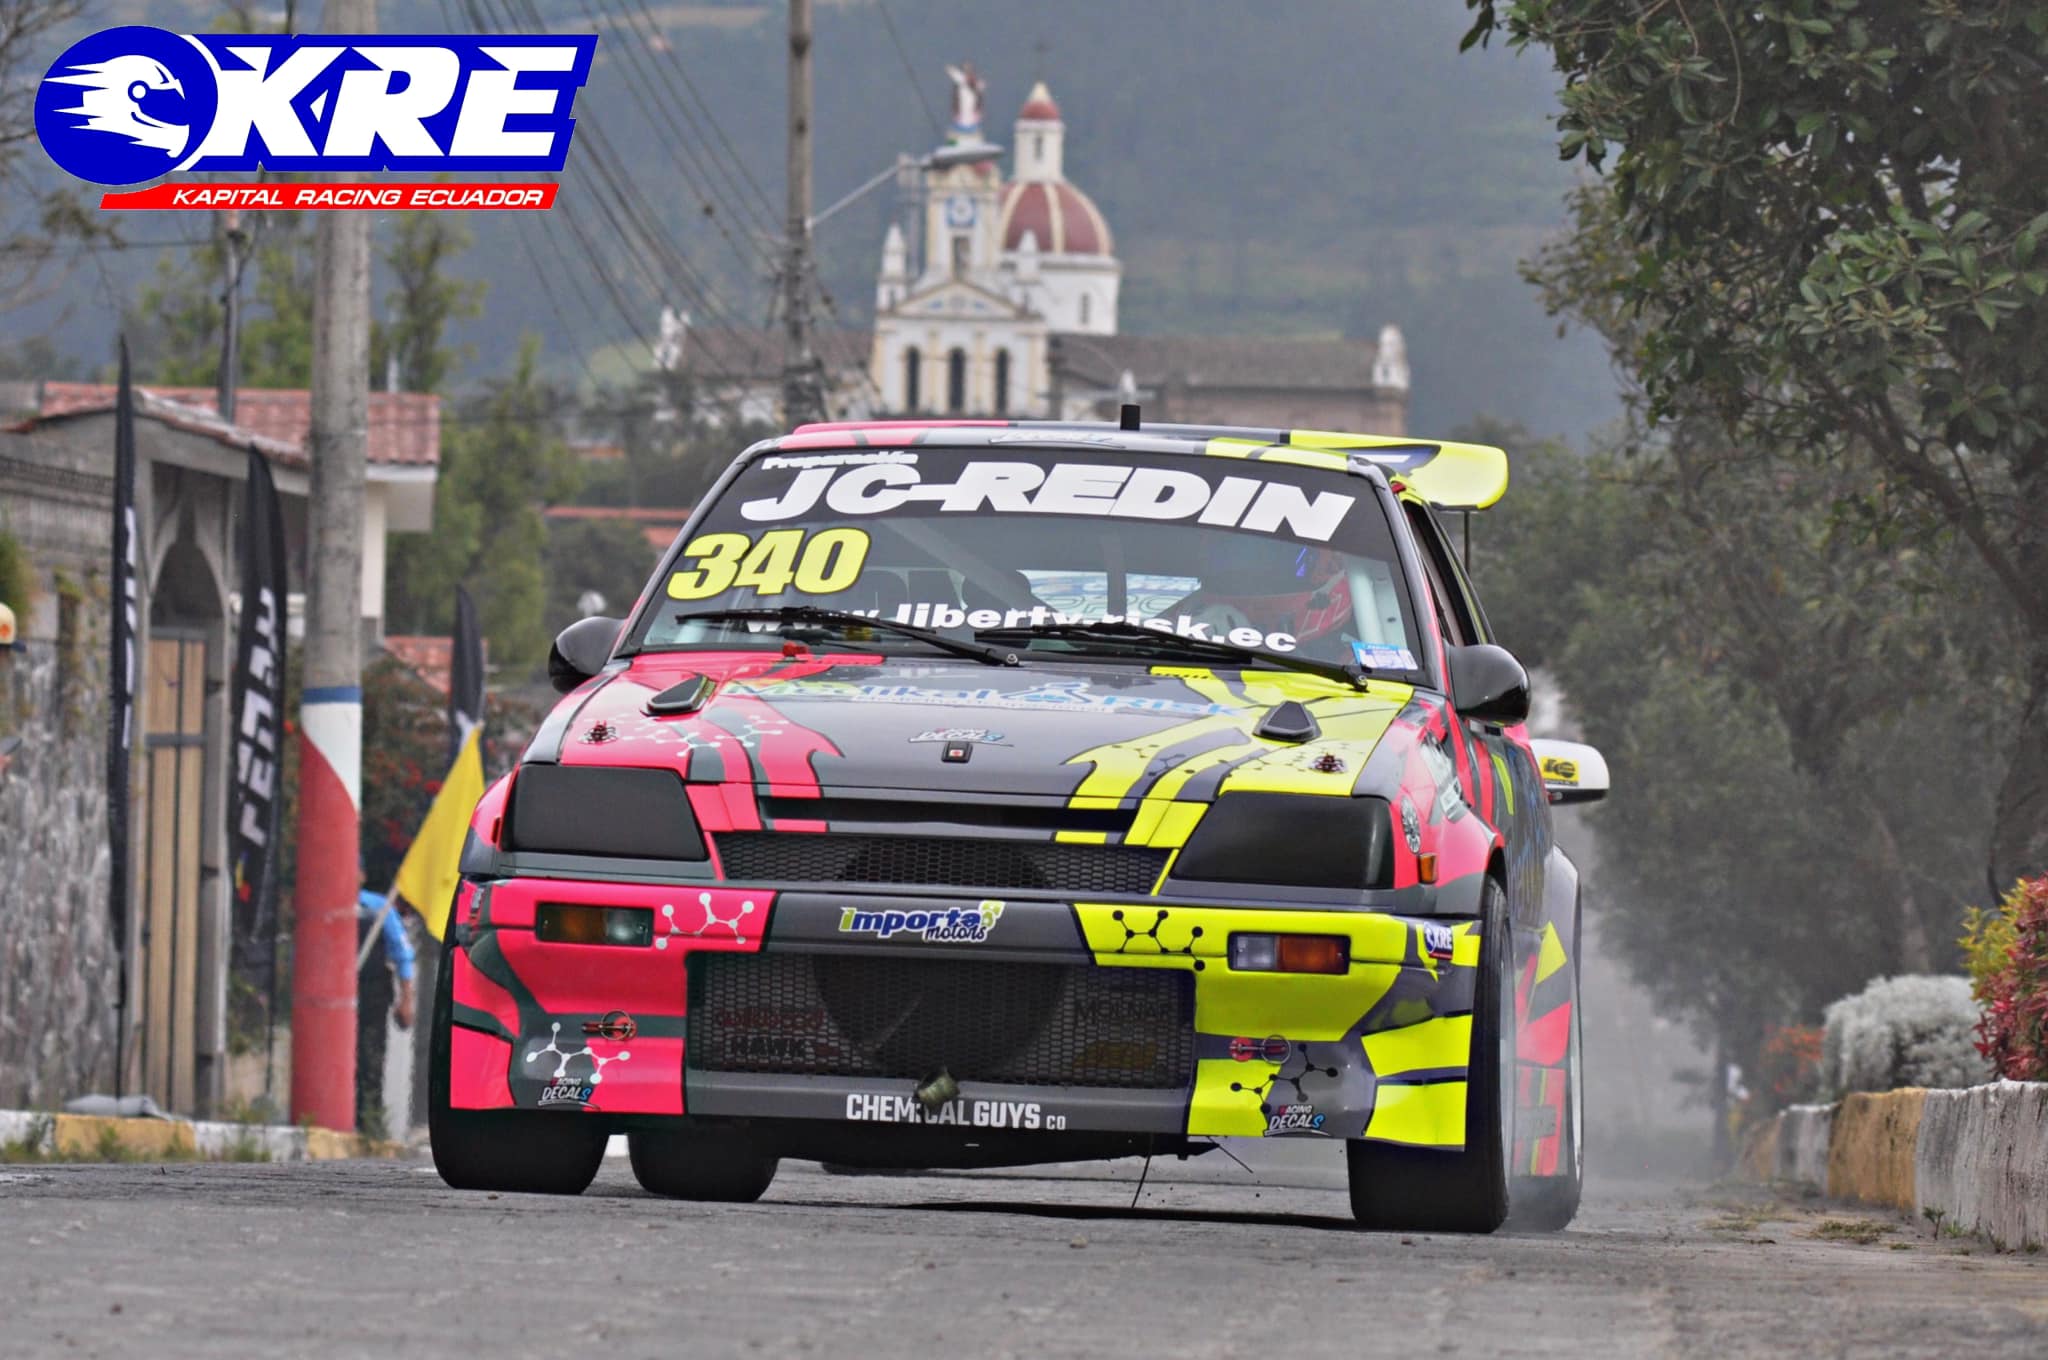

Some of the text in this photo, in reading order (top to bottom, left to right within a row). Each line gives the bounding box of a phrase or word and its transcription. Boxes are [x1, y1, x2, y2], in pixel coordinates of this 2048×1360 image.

[666, 527, 871, 600] 340
[746, 602, 1297, 652] wliberty-risk.ec
[922, 924, 987, 942] motors
[541, 1086, 592, 1101] DECALS
[973, 1101, 1040, 1129] GUYS
[1046, 1115, 1066, 1130] CO
[1268, 1113, 1325, 1130] DECALS
